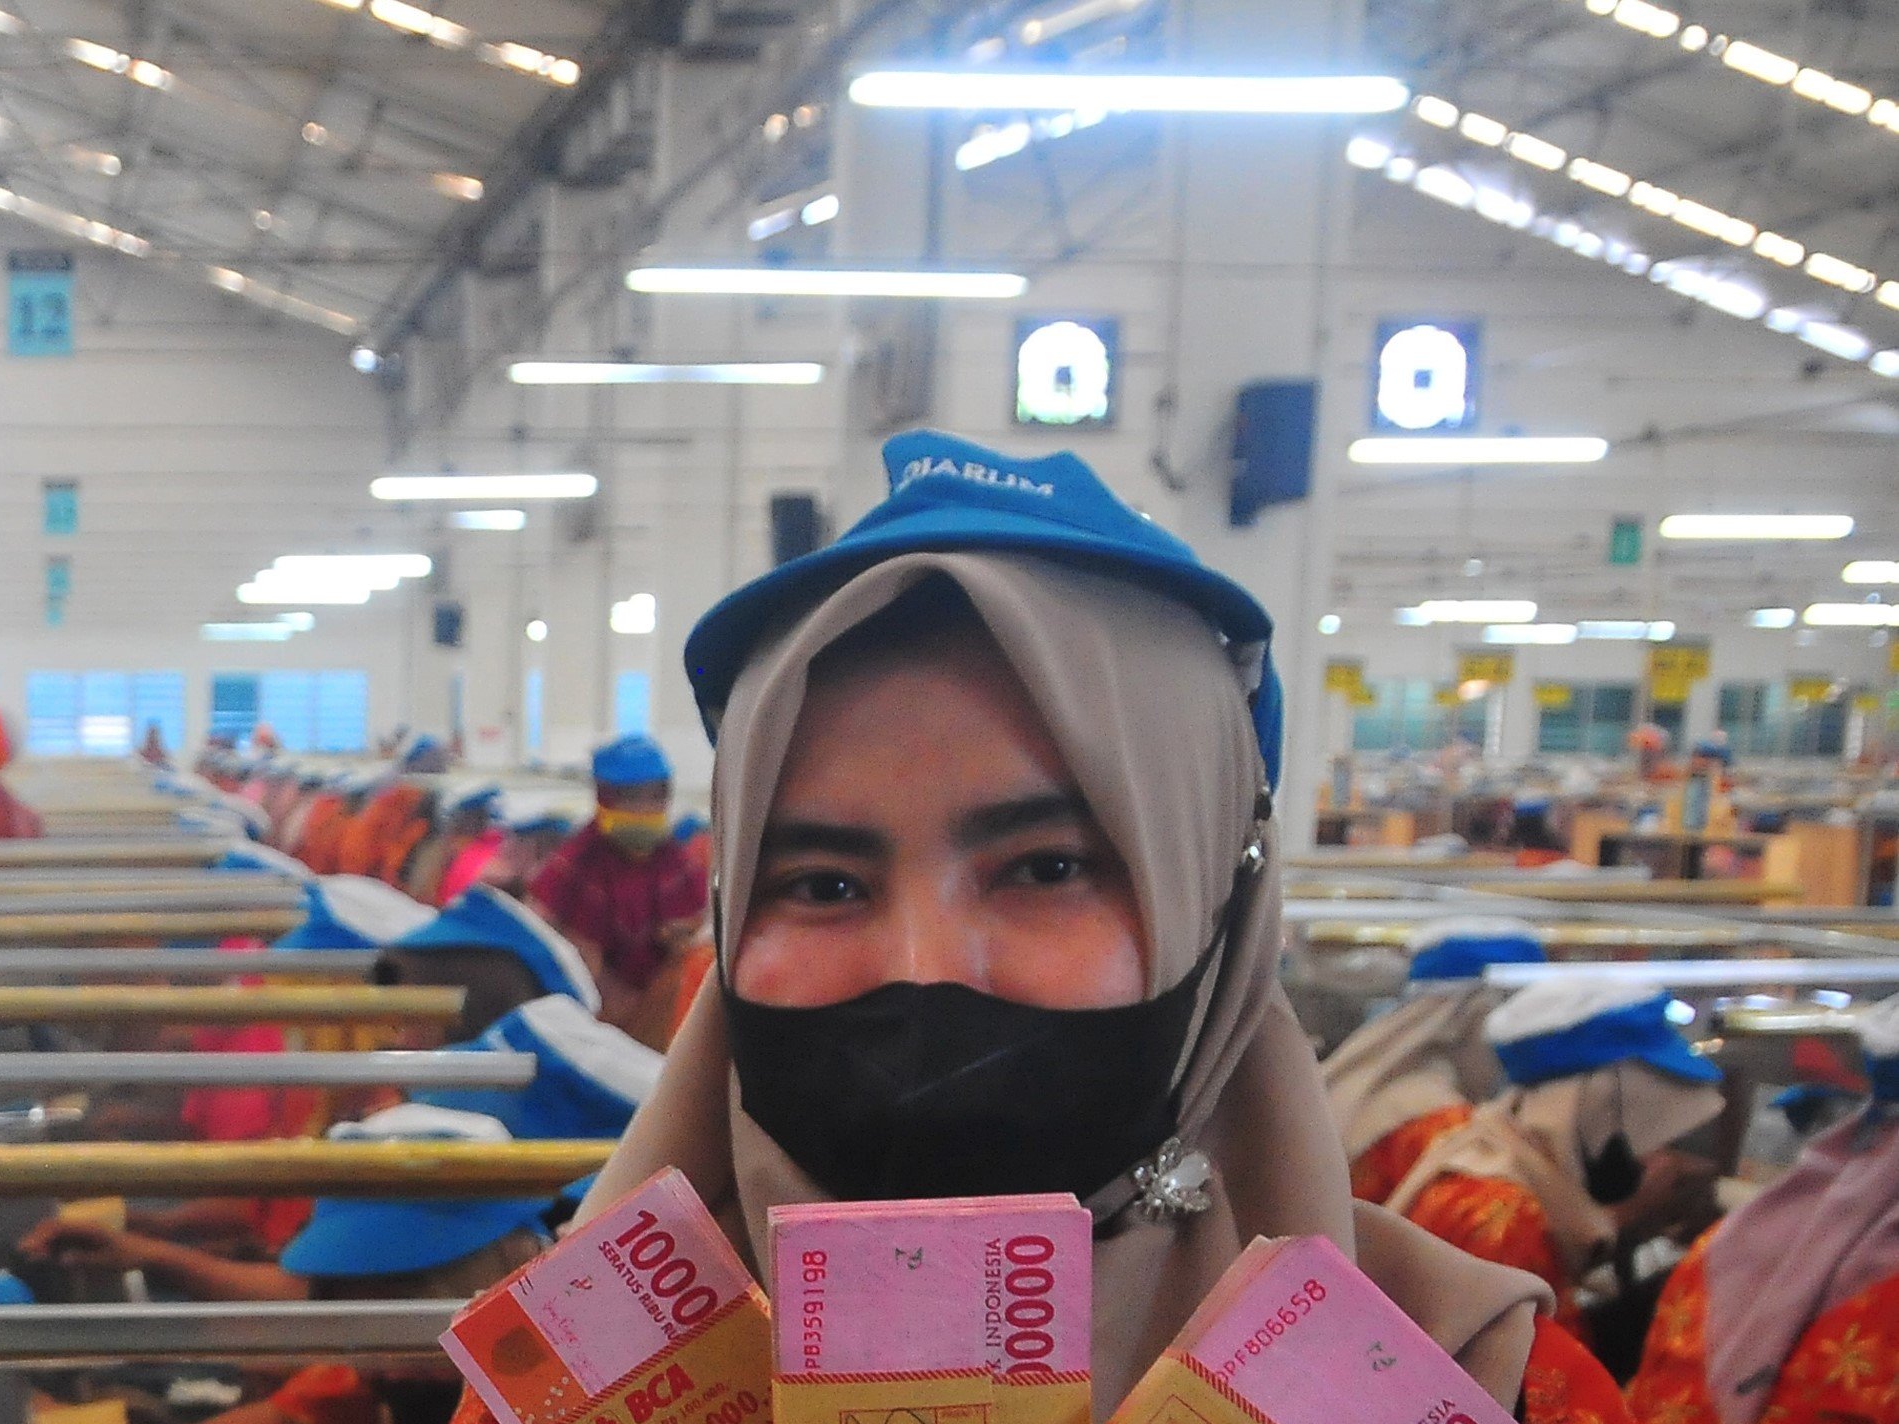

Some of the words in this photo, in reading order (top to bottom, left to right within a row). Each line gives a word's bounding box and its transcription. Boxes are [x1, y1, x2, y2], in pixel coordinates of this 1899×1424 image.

[598, 1241, 644, 1294] SERATUS
[638, 1293, 666, 1322] RIBU
[985, 1238, 1001, 1347] INDONESIA
[624, 1363, 695, 1424] BCA
